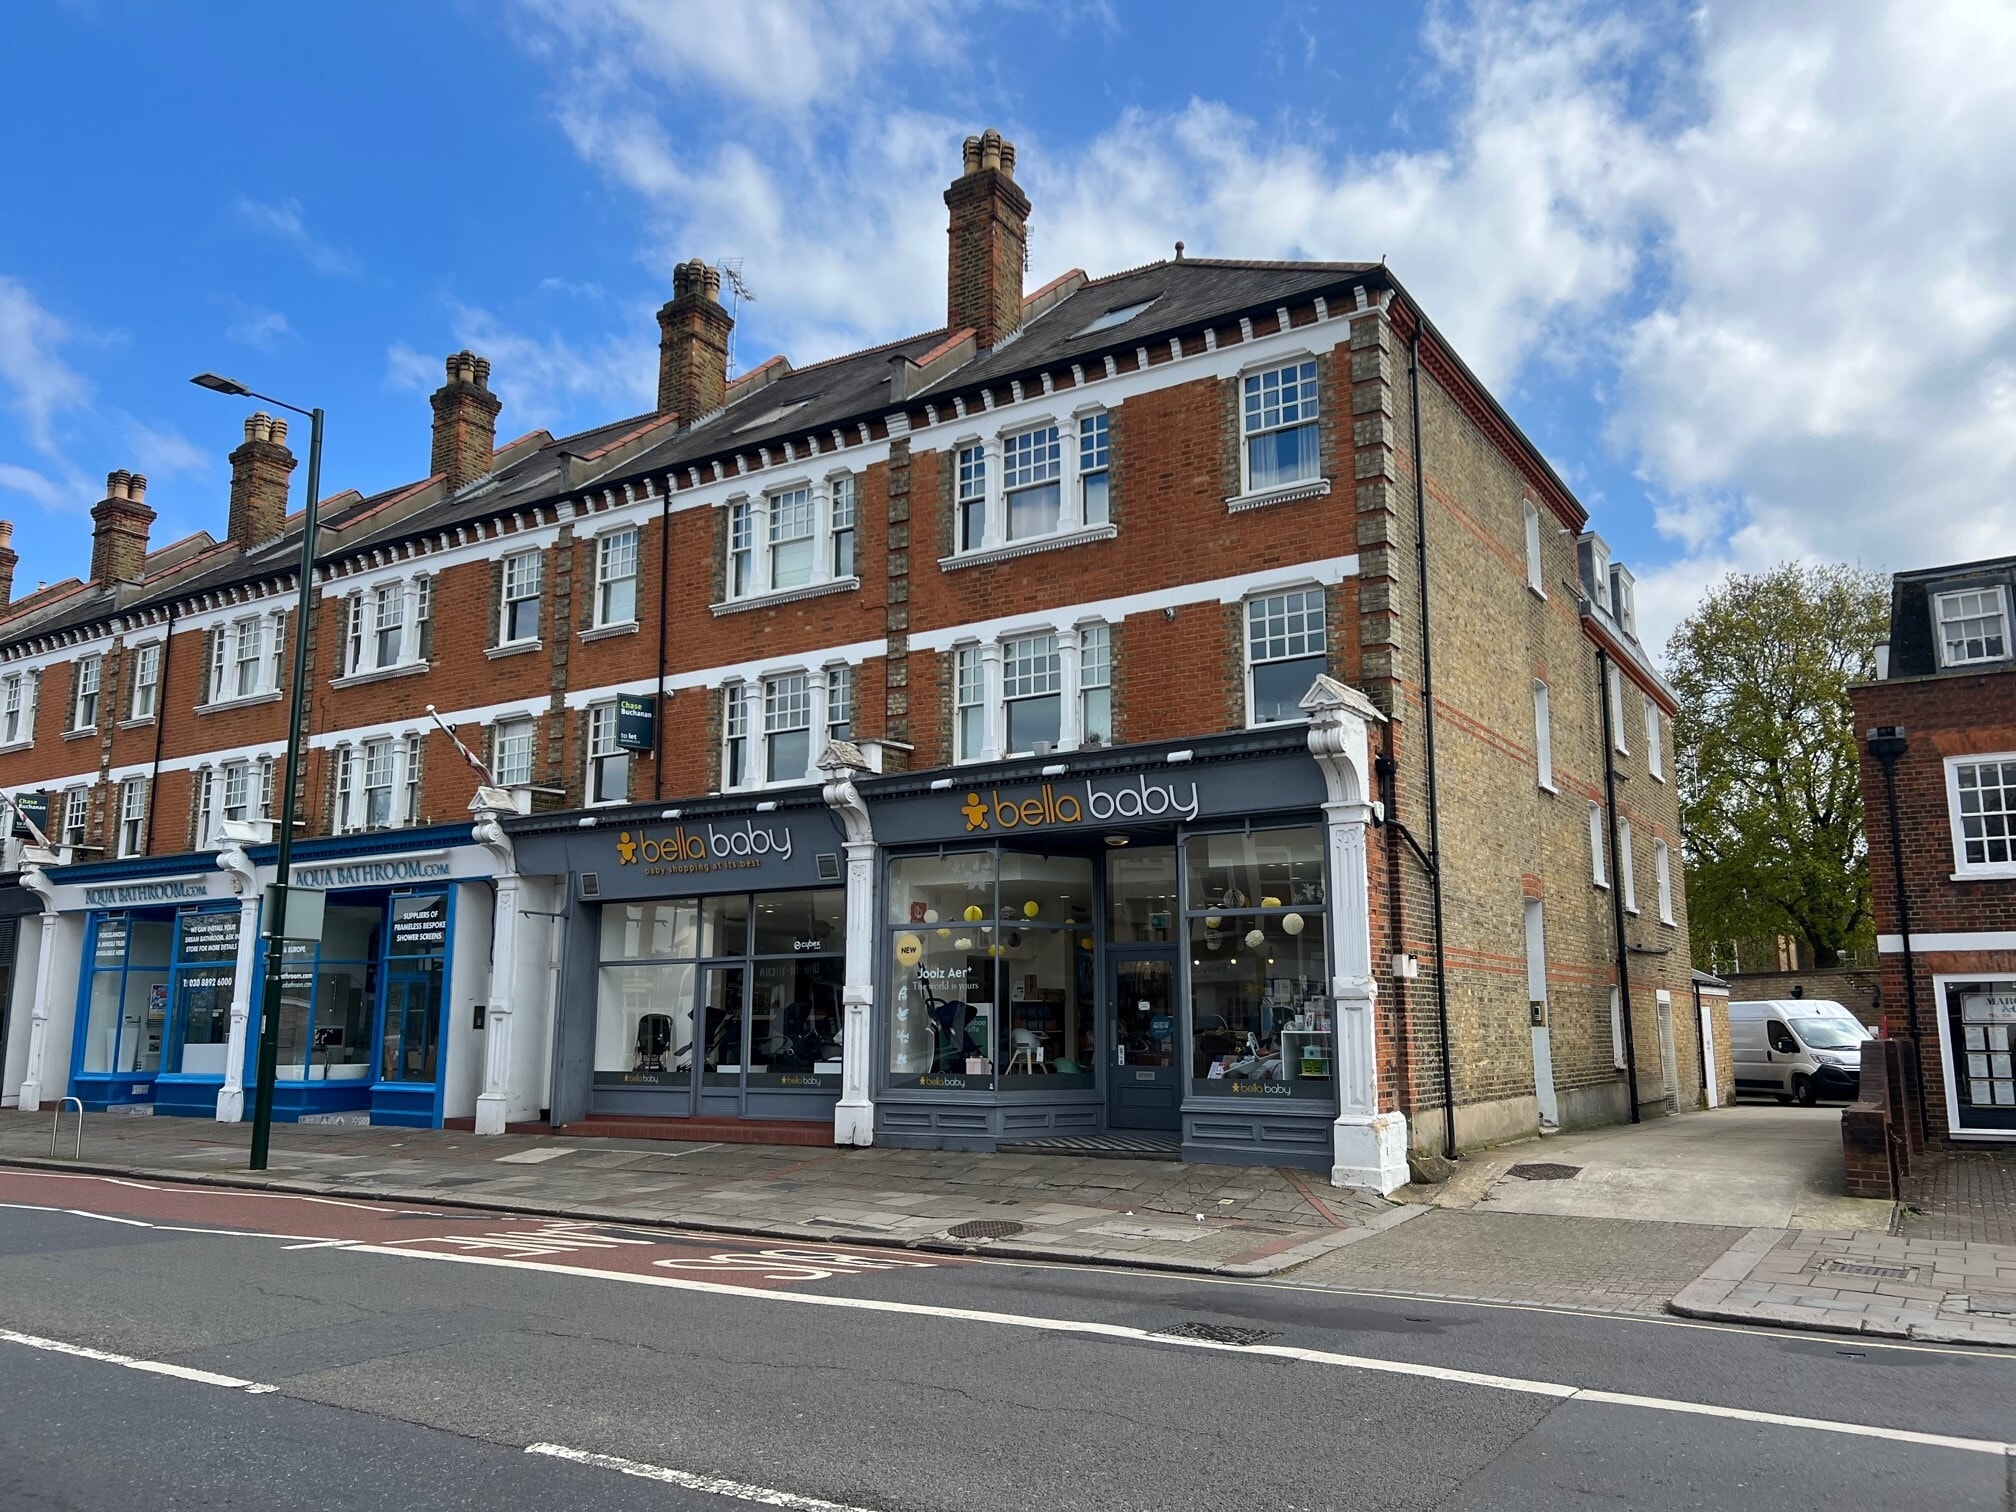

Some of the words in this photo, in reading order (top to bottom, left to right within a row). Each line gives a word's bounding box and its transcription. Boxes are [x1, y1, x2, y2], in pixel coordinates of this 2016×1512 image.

[620, 701, 643, 710] Chase
[621, 708, 652, 718] Buchanan
[992, 784, 1081, 828] bella
[1086, 774, 1199, 821] baby
[639, 826, 706, 863] bella
[708, 820, 792, 861] baby
[645, 867, 666, 876] baby
[668, 863, 709, 874] shopping
[713, 862, 722, 871] at
[740, 859, 761, 868] best
[295, 869, 334, 887] AQUA
[85, 887, 116, 907] AQUA
[403, 911, 430, 920] SUPPLIERS
[430, 910, 439, 918] OF
[190, 926, 198, 934] WE
[198, 925, 207, 933] CAN
[223, 923, 236, 931] YOUR
[394, 922, 422, 930] FRAMELESS
[422, 921, 447, 930] BESPOKE
[396, 933, 419, 942] SHOWER
[419, 932, 442, 941] SCREENS
[185, 945, 198, 953] STORE
[207, 944, 220, 952] MORE
[220, 943, 238, 951] DETAILS
[288, 945, 307, 953] EUROPE
[801, 939, 821, 950] cybex
[916, 967, 945, 979] Joolz
[183, 979, 188, 988] T:
[189, 978, 200, 987] 020
[200, 978, 216, 987] 8892
[216, 977, 233, 986] 6000
[950, 982, 957, 990] is
[958, 982, 979, 991] yours
[642, 1073, 659, 1084] baby
[802, 1075, 821, 1086] baby
[944, 1076, 966, 1088] baby
[1263, 1083, 1291, 1096] baby
[382, 1222, 722, 1258] LANE
[651, 1249, 938, 1281] BUS
